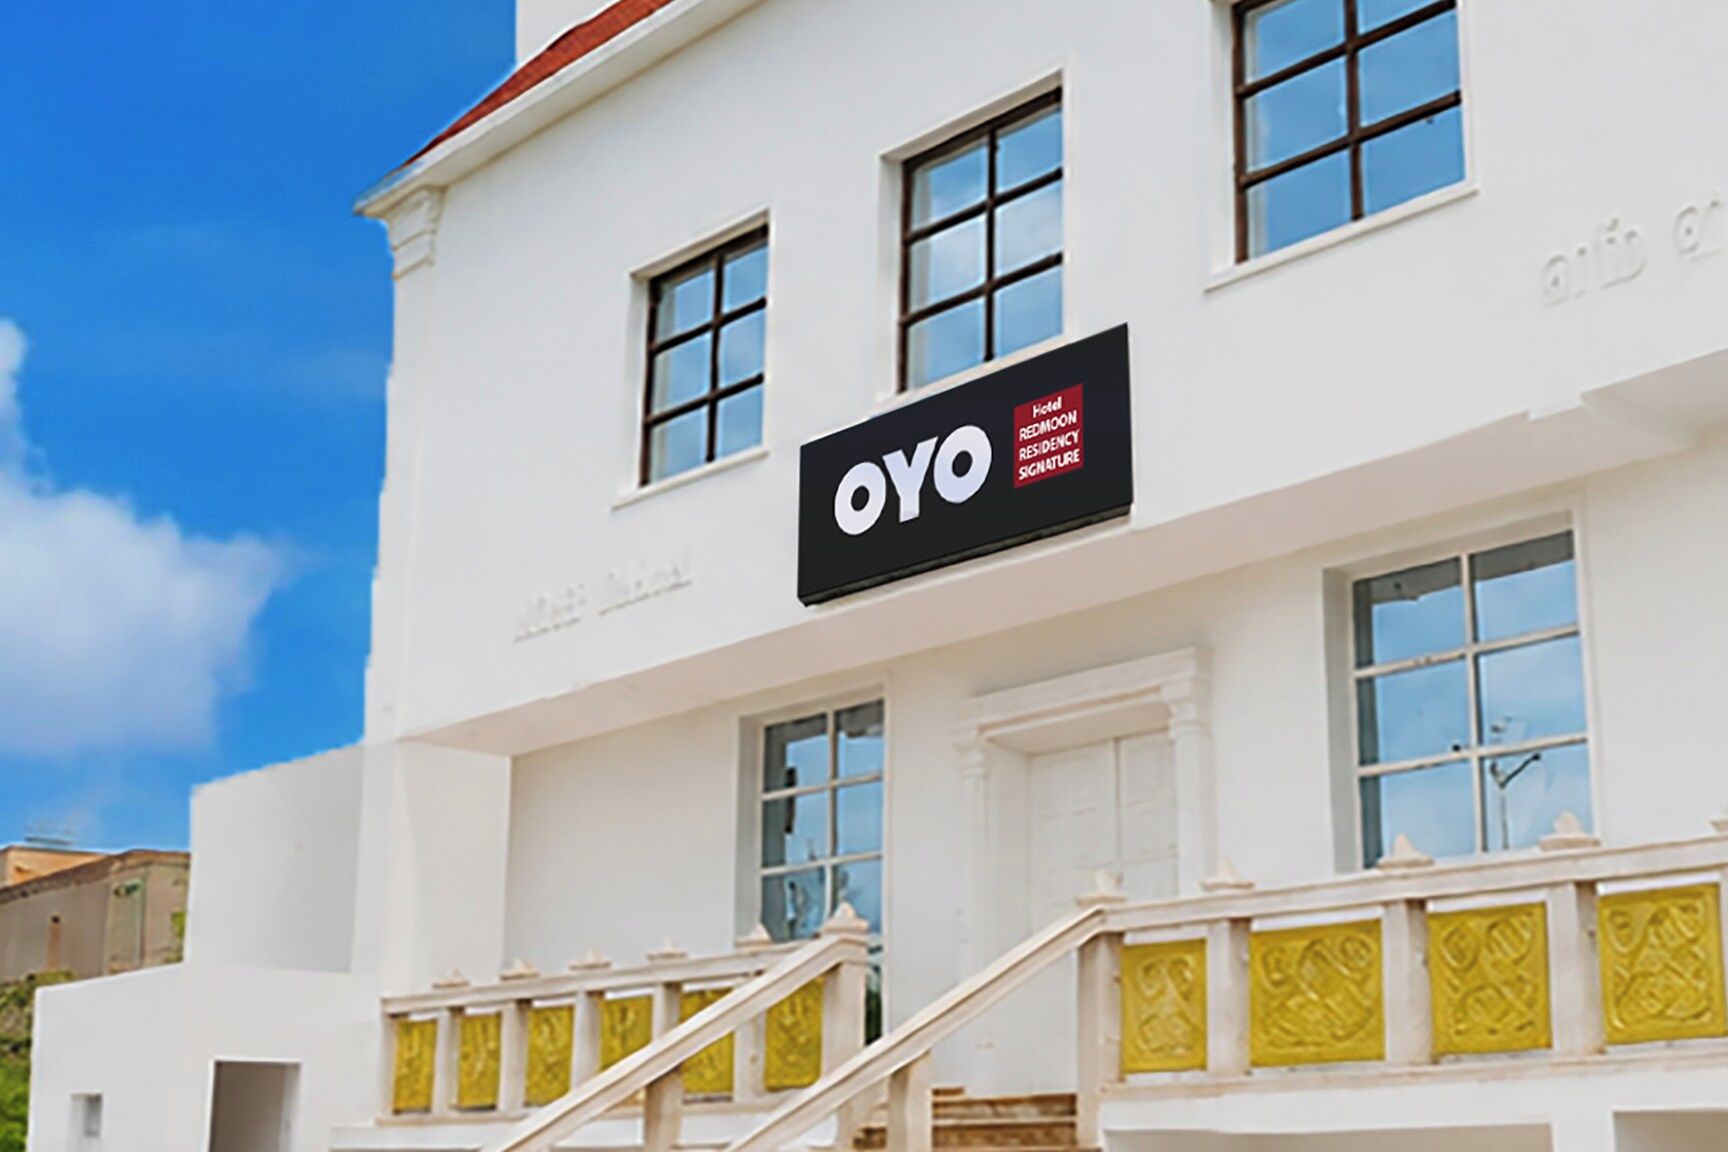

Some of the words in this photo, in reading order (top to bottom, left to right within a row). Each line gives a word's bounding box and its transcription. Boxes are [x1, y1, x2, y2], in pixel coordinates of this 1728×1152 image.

[1033, 396, 1062, 418] Hotel
[1019, 410, 1078, 441] REDMOON
[1019, 430, 1080, 461] RESIDENCY
[1018, 449, 1080, 480] SIGNATURE
[835, 425, 992, 536] OYO
